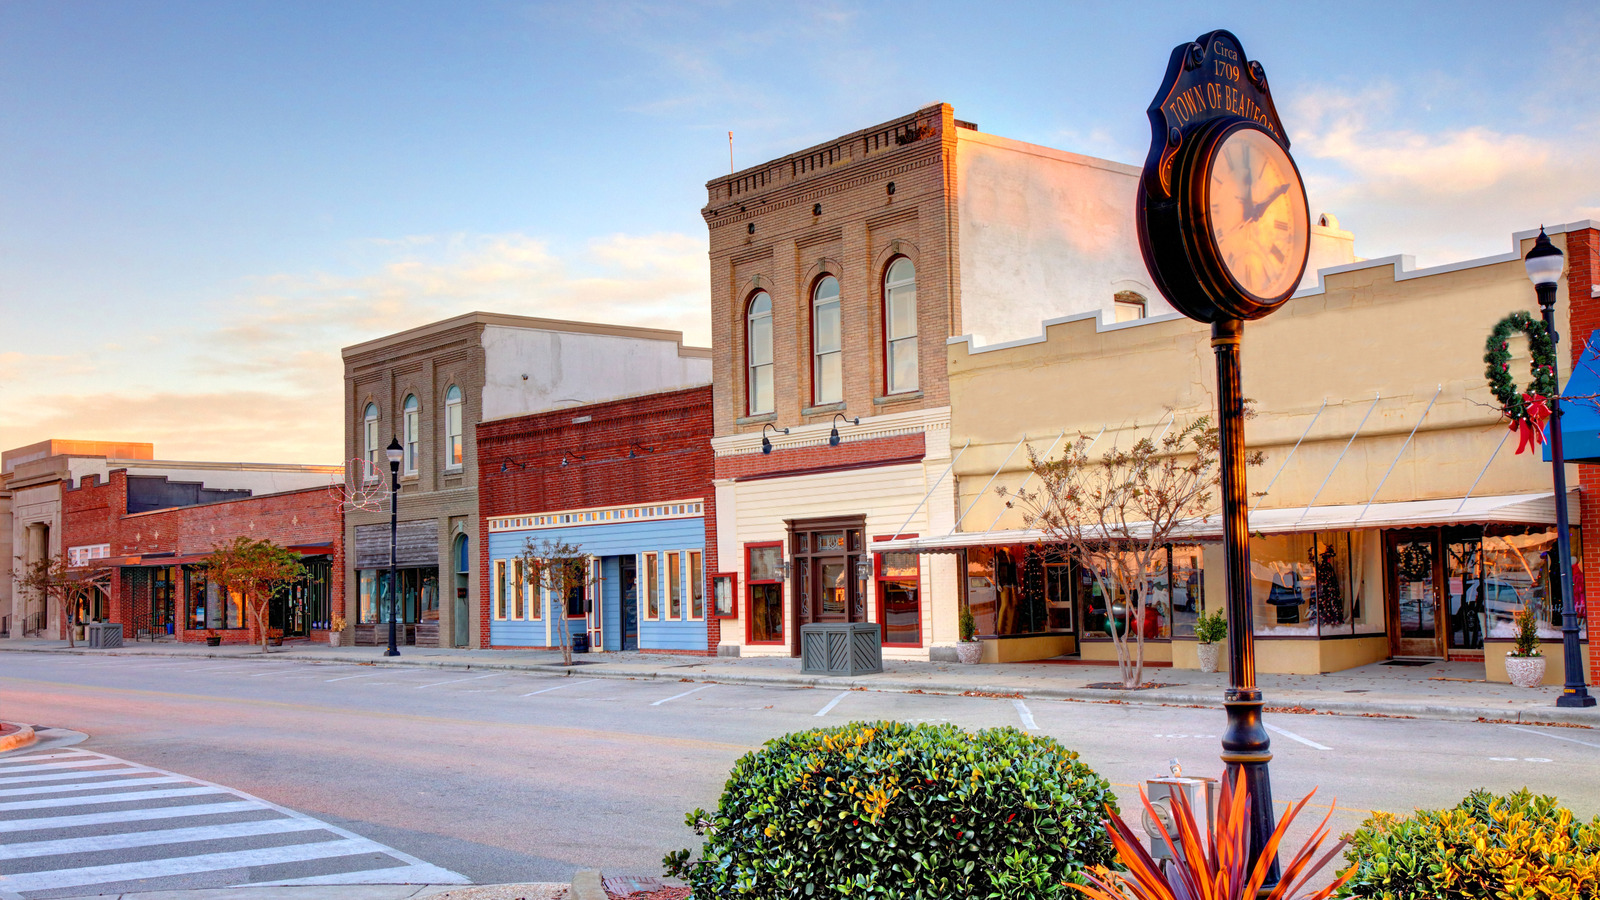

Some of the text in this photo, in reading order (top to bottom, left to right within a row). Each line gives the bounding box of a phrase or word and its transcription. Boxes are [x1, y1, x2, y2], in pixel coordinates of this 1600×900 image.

[1213, 40, 1238, 61] Circa
[1214, 59, 1240, 82] 1709
[1169, 84, 1207, 127] TOWN
[1207, 82, 1222, 109] OF
